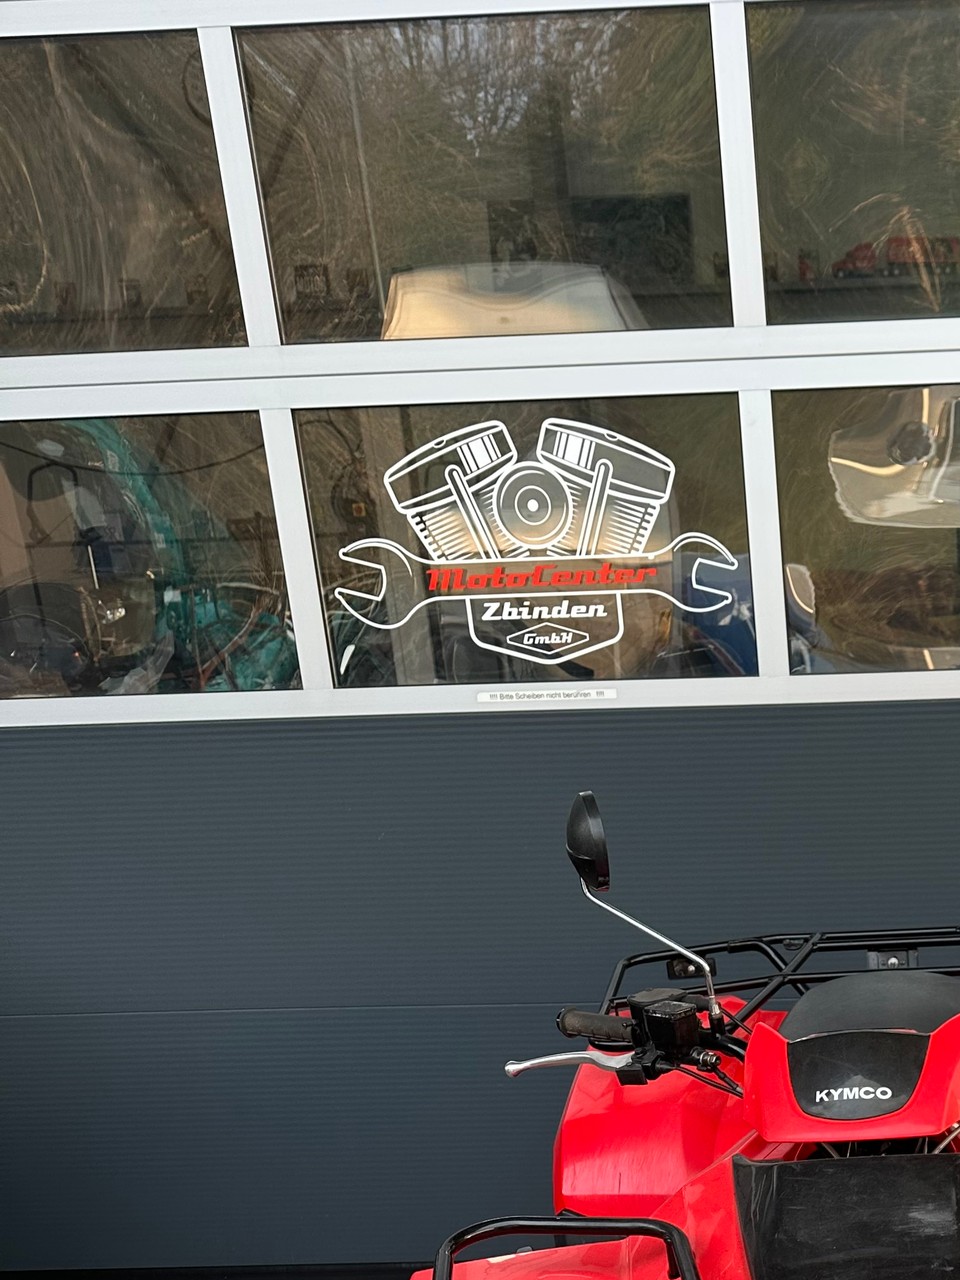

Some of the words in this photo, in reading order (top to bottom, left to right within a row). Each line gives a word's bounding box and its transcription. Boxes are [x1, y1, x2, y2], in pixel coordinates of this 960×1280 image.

[426, 564, 657, 591] MotoCenter
[481, 600, 608, 622] Zbinden
[522, 630, 573, 646] GmbH
[515, 692, 545, 700] Scheiben
[546, 691, 561, 699] nicht
[815, 1086, 893, 1103] KYMCO
